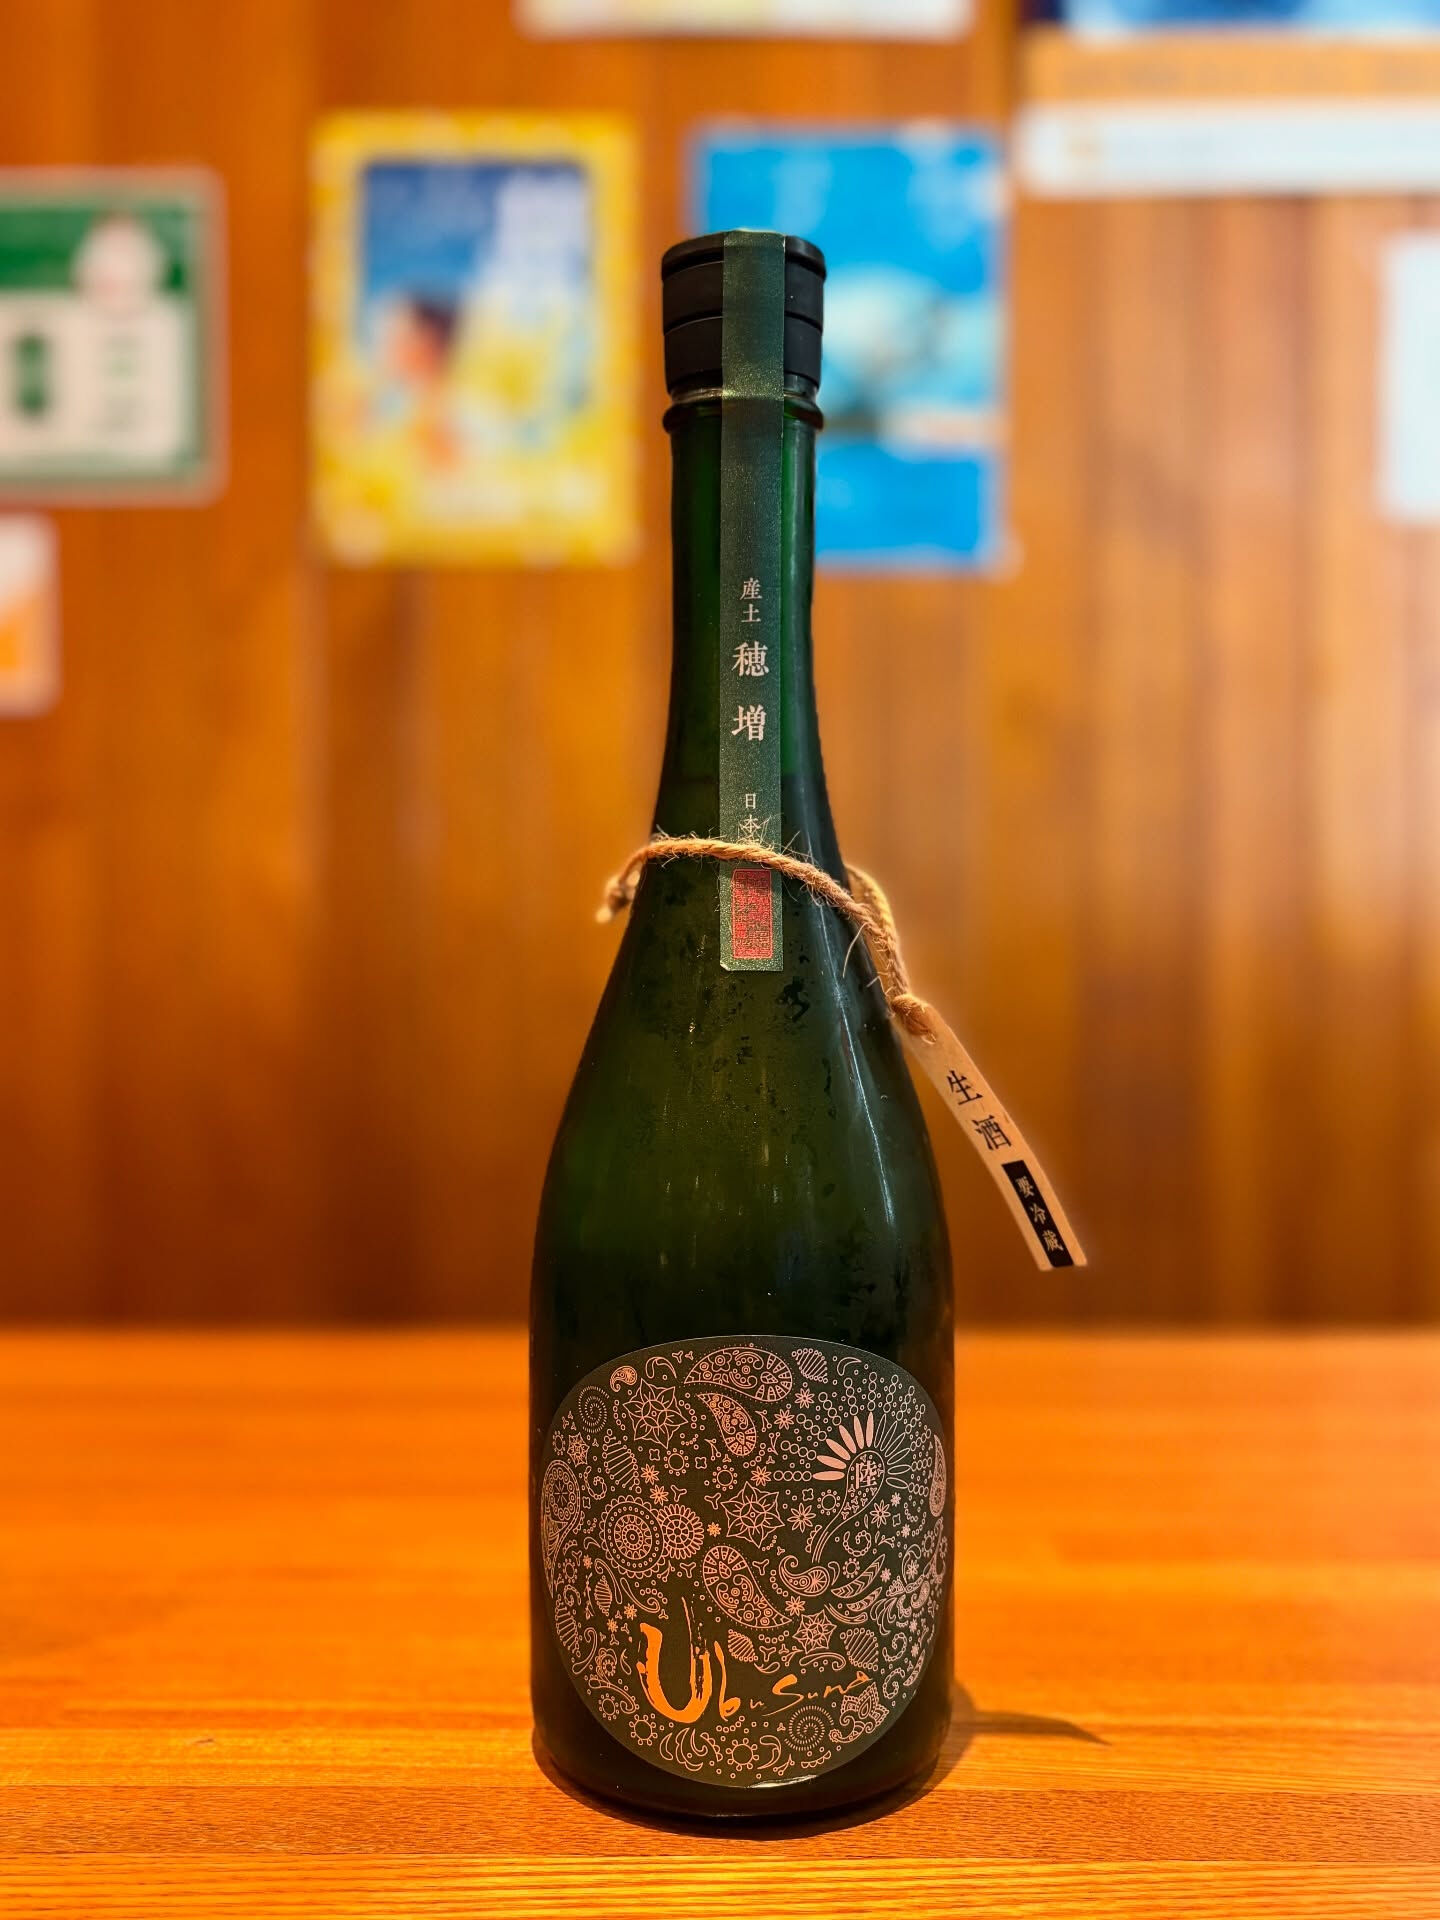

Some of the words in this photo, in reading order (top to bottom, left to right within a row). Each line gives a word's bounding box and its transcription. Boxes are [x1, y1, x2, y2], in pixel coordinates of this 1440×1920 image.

[739, 577, 763, 624] 産土
[731, 641, 769, 742] 穂増
[743, 793, 762, 844] 日本
[946, 1070, 1013, 1151] 生酒
[1015, 1176, 1065, 1253] 要冷蔵
